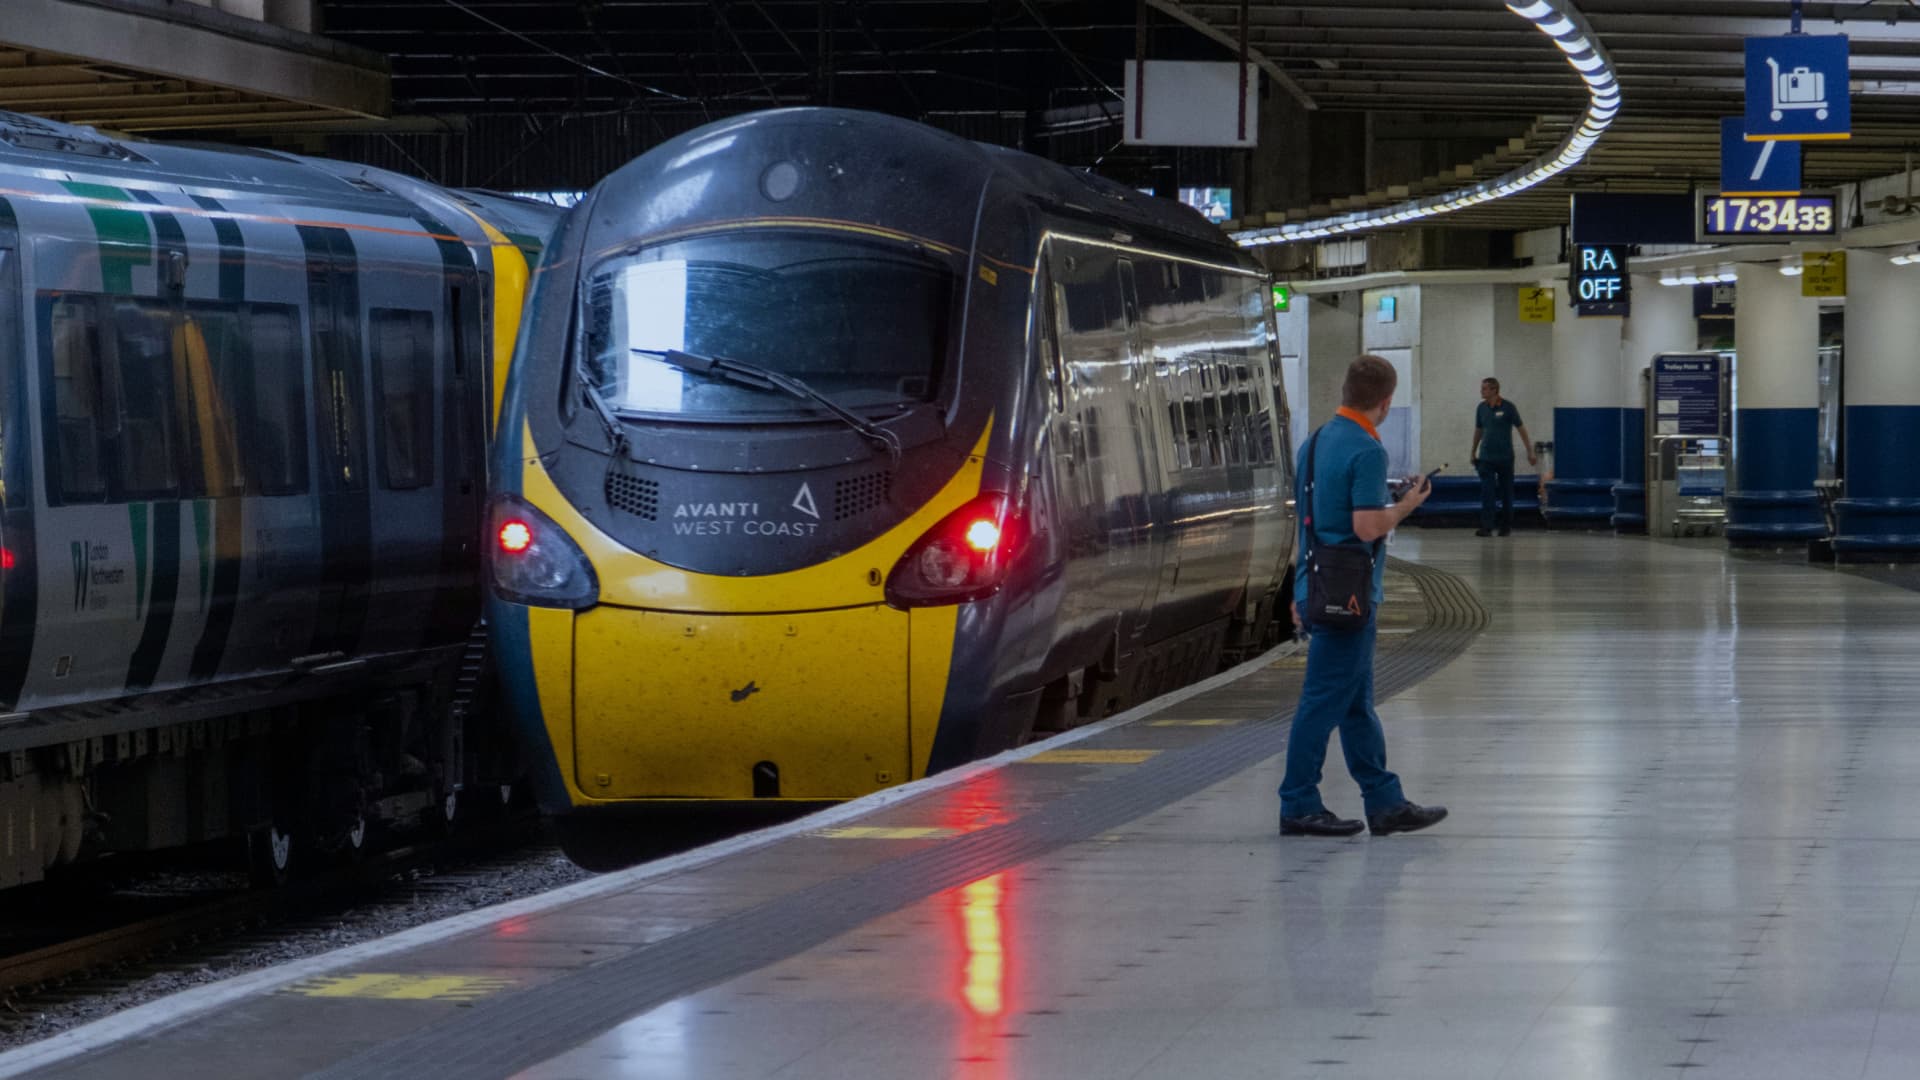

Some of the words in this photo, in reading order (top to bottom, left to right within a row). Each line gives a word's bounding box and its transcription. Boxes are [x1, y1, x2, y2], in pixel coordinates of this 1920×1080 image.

[1583, 248, 1617, 271] RA
[1579, 277, 1622, 300] OFF
[674, 502, 759, 518] AVANTI
[673, 520, 735, 536] WEST
[743, 520, 819, 537] COAST
